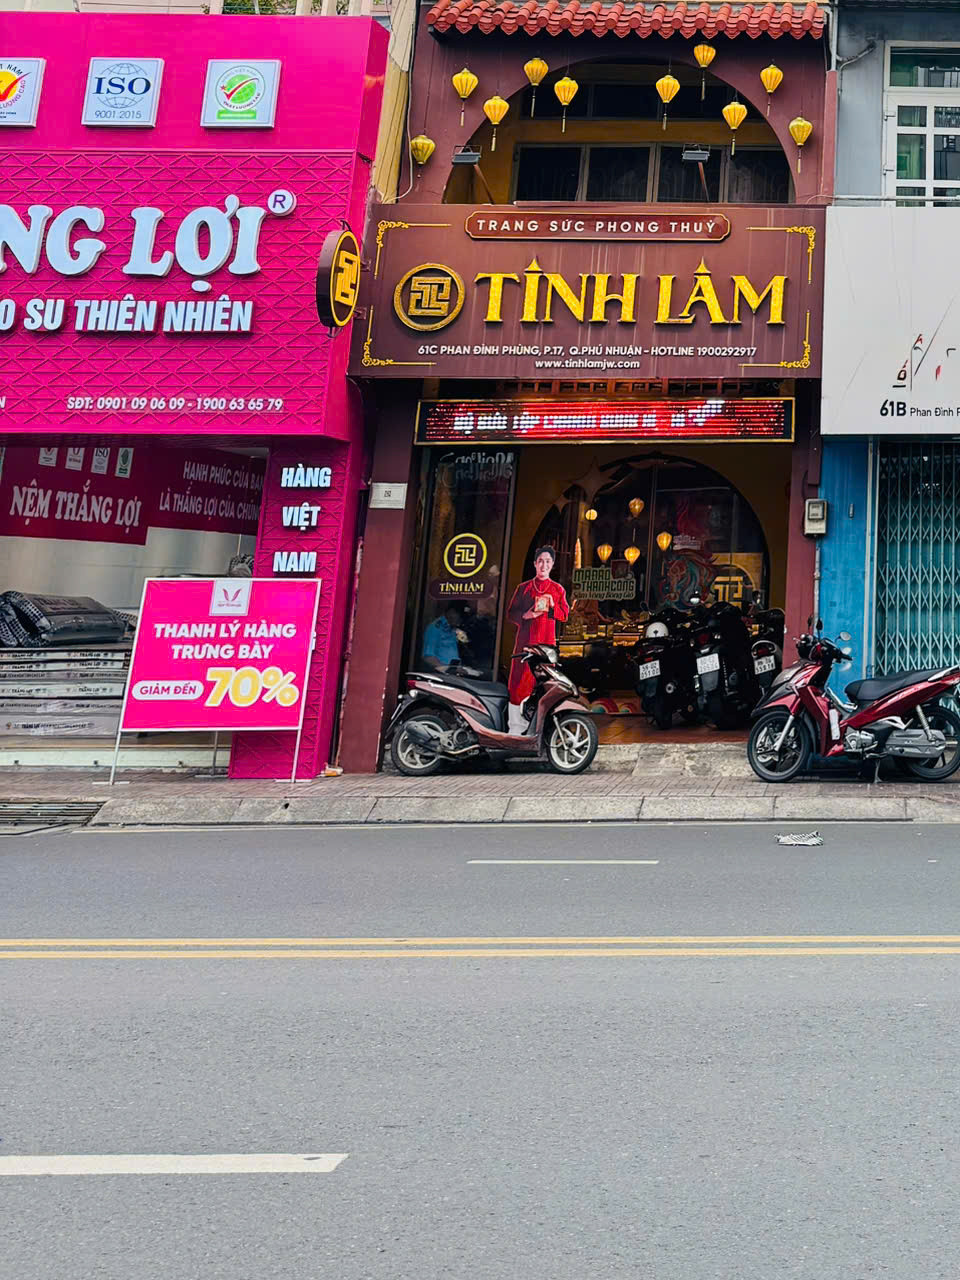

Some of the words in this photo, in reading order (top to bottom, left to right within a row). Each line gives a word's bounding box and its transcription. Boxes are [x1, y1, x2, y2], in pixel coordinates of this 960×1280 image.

[92, 76, 151, 95] ISO
[477, 220, 540, 232] TRANG
[549, 218, 587, 233] SỨC
[595, 221, 660, 233] PHONG
[122, 194, 267, 292] LỢI
[654, 256, 789, 325] LÂM
[24, 298, 66, 331] SU
[74, 294, 158, 332] THIÊN
[162, 294, 253, 333] NHIÊN
[417, 345, 438, 355] 61C
[440, 345, 471, 355] PHAN
[543, 345, 565, 357] P.17,
[605, 345, 642, 358] NHUẬN
[651, 346, 694, 356] HOTLINE
[697, 346, 757, 357] 1900292917
[67, 397, 94, 410] SĐT:
[97, 397, 127, 410] 0901
[130, 397, 148, 410] 09
[150, 397, 166, 410] 06
[168, 398, 185, 410] 09
[196, 398, 226, 411] 1900
[228, 398, 245, 411] 63
[247, 398, 264, 411] 65
[266, 398, 283, 411] 79
[879, 399, 907, 417] 61B
[910, 407, 932, 417] Phan
[281, 463, 332, 488] HÀNG
[9, 478, 52, 526] NỆM
[55, 479, 113, 524] THẮNG
[114, 496, 142, 533] LỢI
[282, 502, 321, 531] VIỆT
[272, 551, 318, 572] NAM
[153, 623, 217, 638] THANH
[219, 620, 242, 638] LÝ
[243, 620, 297, 638] HÀNG
[171, 643, 236, 660] TRƯNG
[237, 641, 274, 659] BÀY
[139, 683, 171, 695] GIẢM
[173, 682, 197, 695] ĐẾN
[204, 666, 300, 707] 70%
